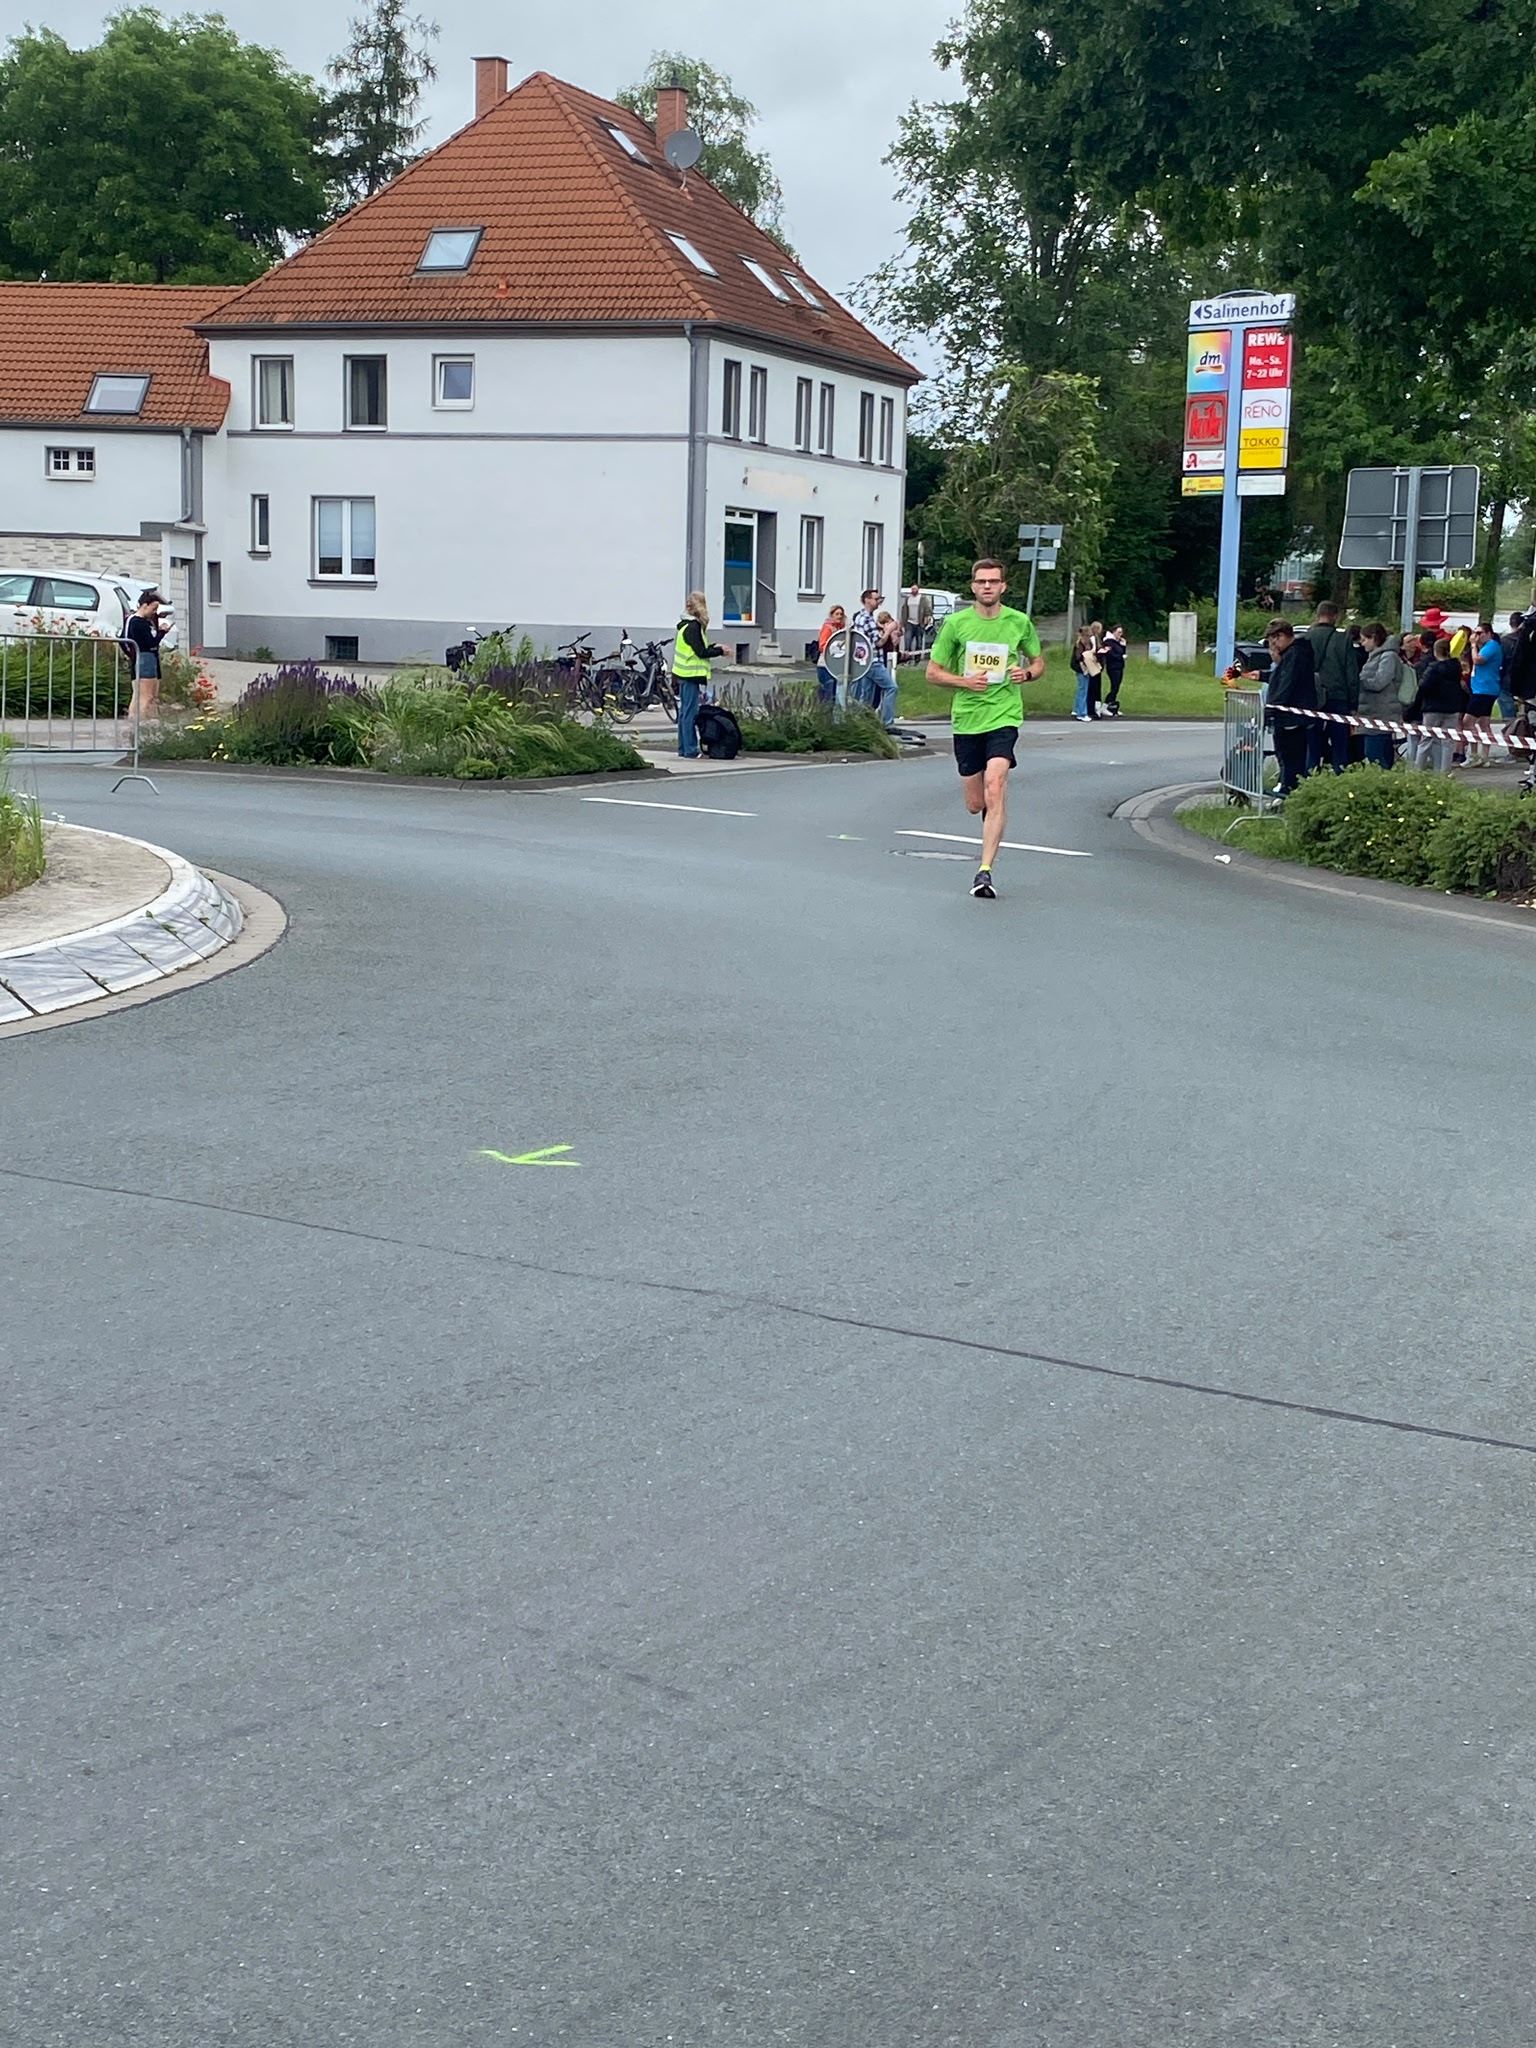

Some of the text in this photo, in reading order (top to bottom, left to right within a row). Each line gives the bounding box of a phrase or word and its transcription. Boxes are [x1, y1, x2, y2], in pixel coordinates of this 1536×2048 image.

[1203, 299, 1286, 319] Salinenhof
[1247, 333, 1285, 347] REWE
[1200, 351, 1221, 365] dm
[1268, 368, 1284, 378] Uhr
[1244, 405, 1282, 419] RENO
[973, 654, 1000, 666] 1506
